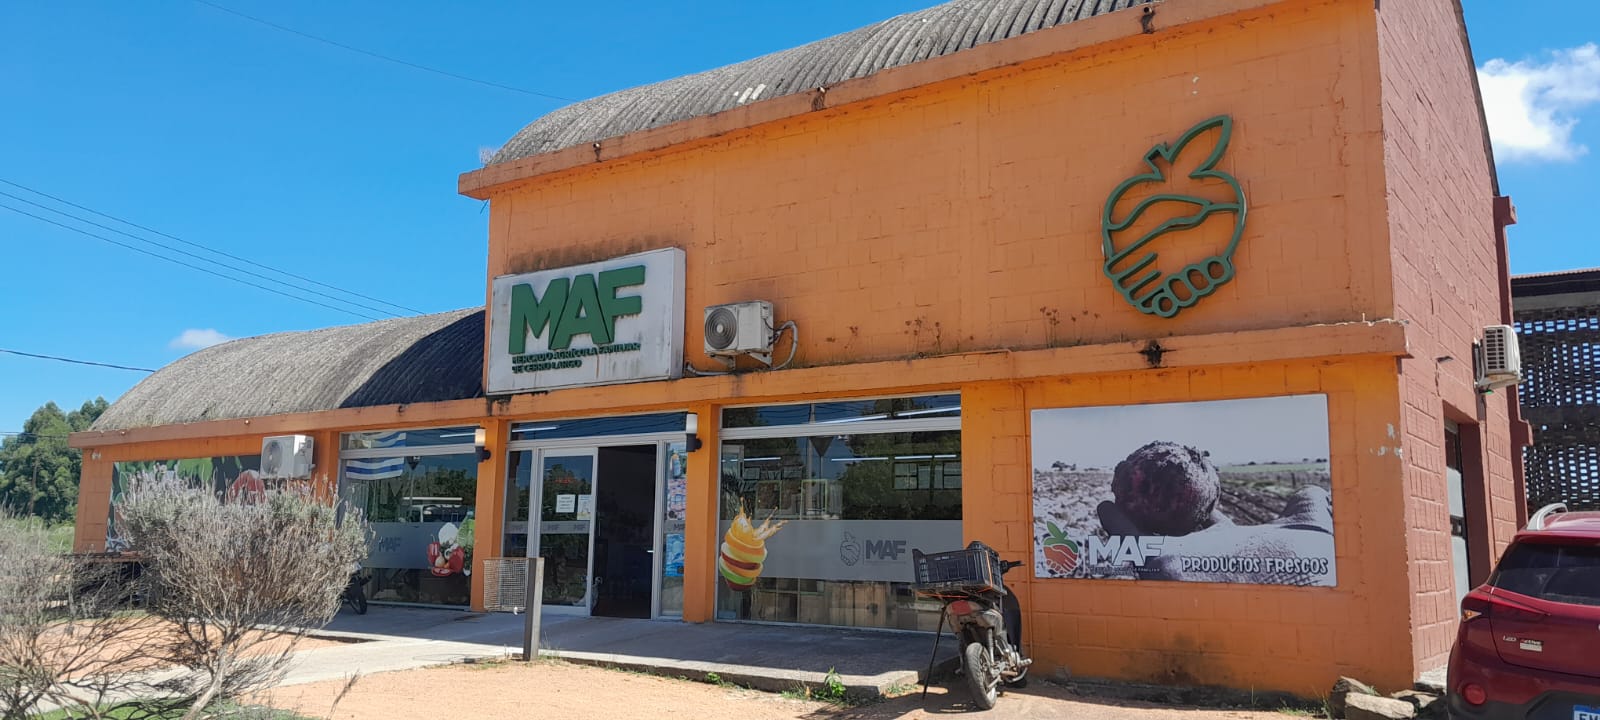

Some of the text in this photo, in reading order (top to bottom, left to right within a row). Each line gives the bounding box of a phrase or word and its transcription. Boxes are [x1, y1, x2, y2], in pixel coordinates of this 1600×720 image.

[509, 265, 646, 354] MAF
[865, 540, 906, 560] MAF
[1088, 535, 1165, 566] MAF
[1180, 556, 1260, 573] PRODUCTOS
